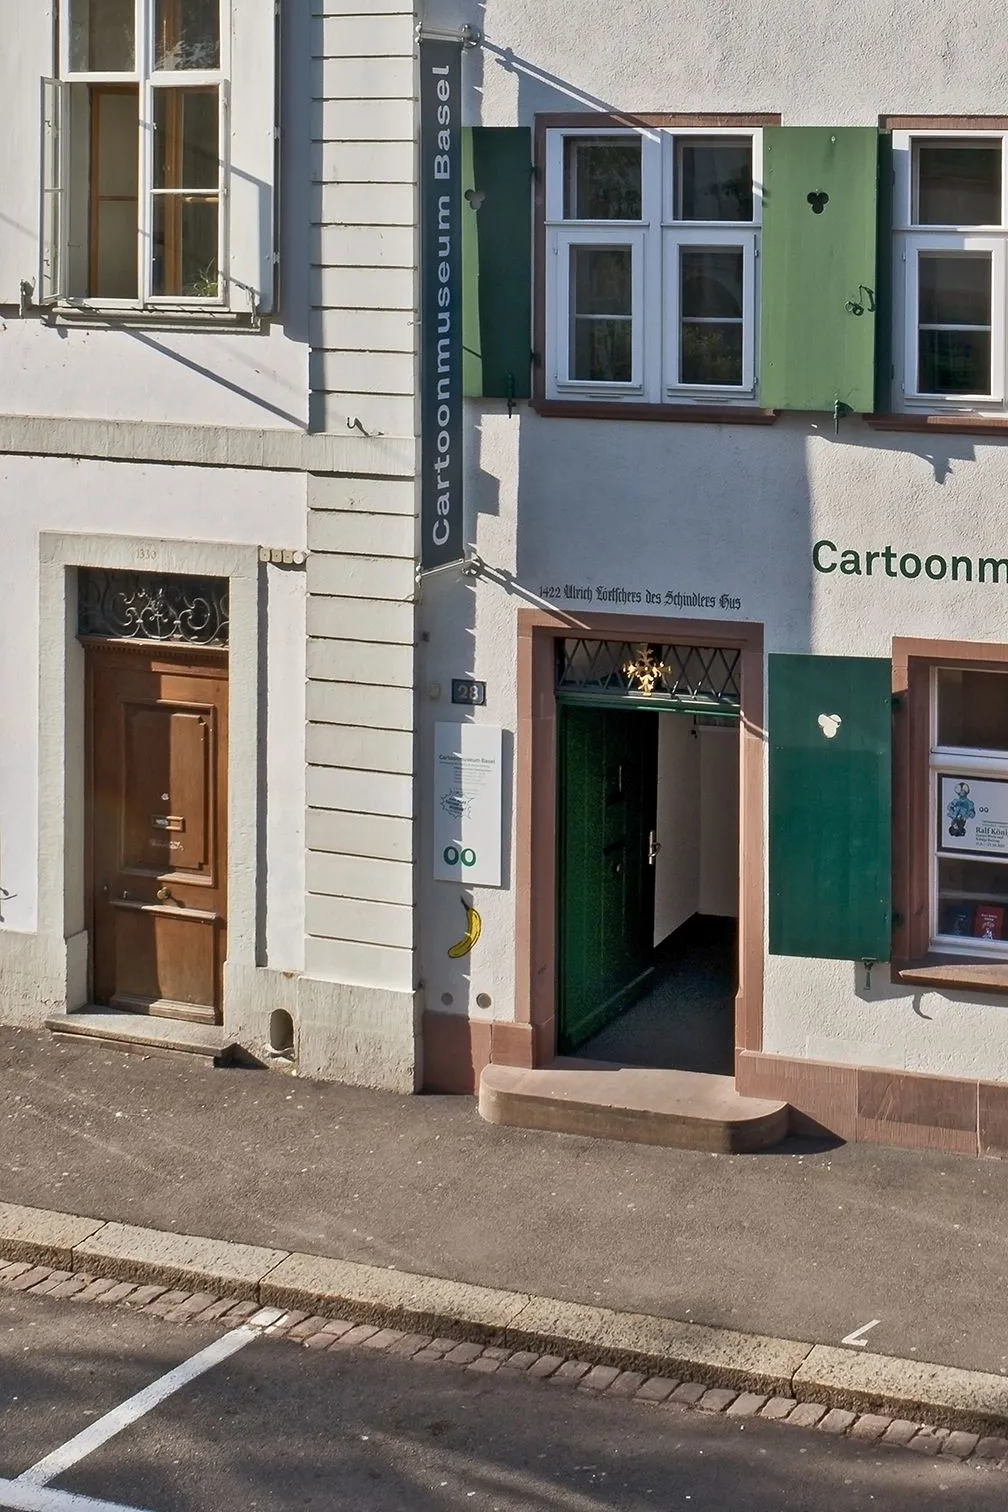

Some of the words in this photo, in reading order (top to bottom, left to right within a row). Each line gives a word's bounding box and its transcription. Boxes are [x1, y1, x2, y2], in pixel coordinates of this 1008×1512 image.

[432, 65, 452, 180] Basel
[432, 193, 452, 548] Cartoonmuseum
[540, 586, 560, 599] 1422
[564, 584, 593, 603] Ulrich
[645, 589, 662, 605] des
[664, 590, 716, 610] Schindlers
[718, 594, 741, 610] Hus
[458, 684, 479, 700] 28
[975, 826, 991, 835] Ralf
